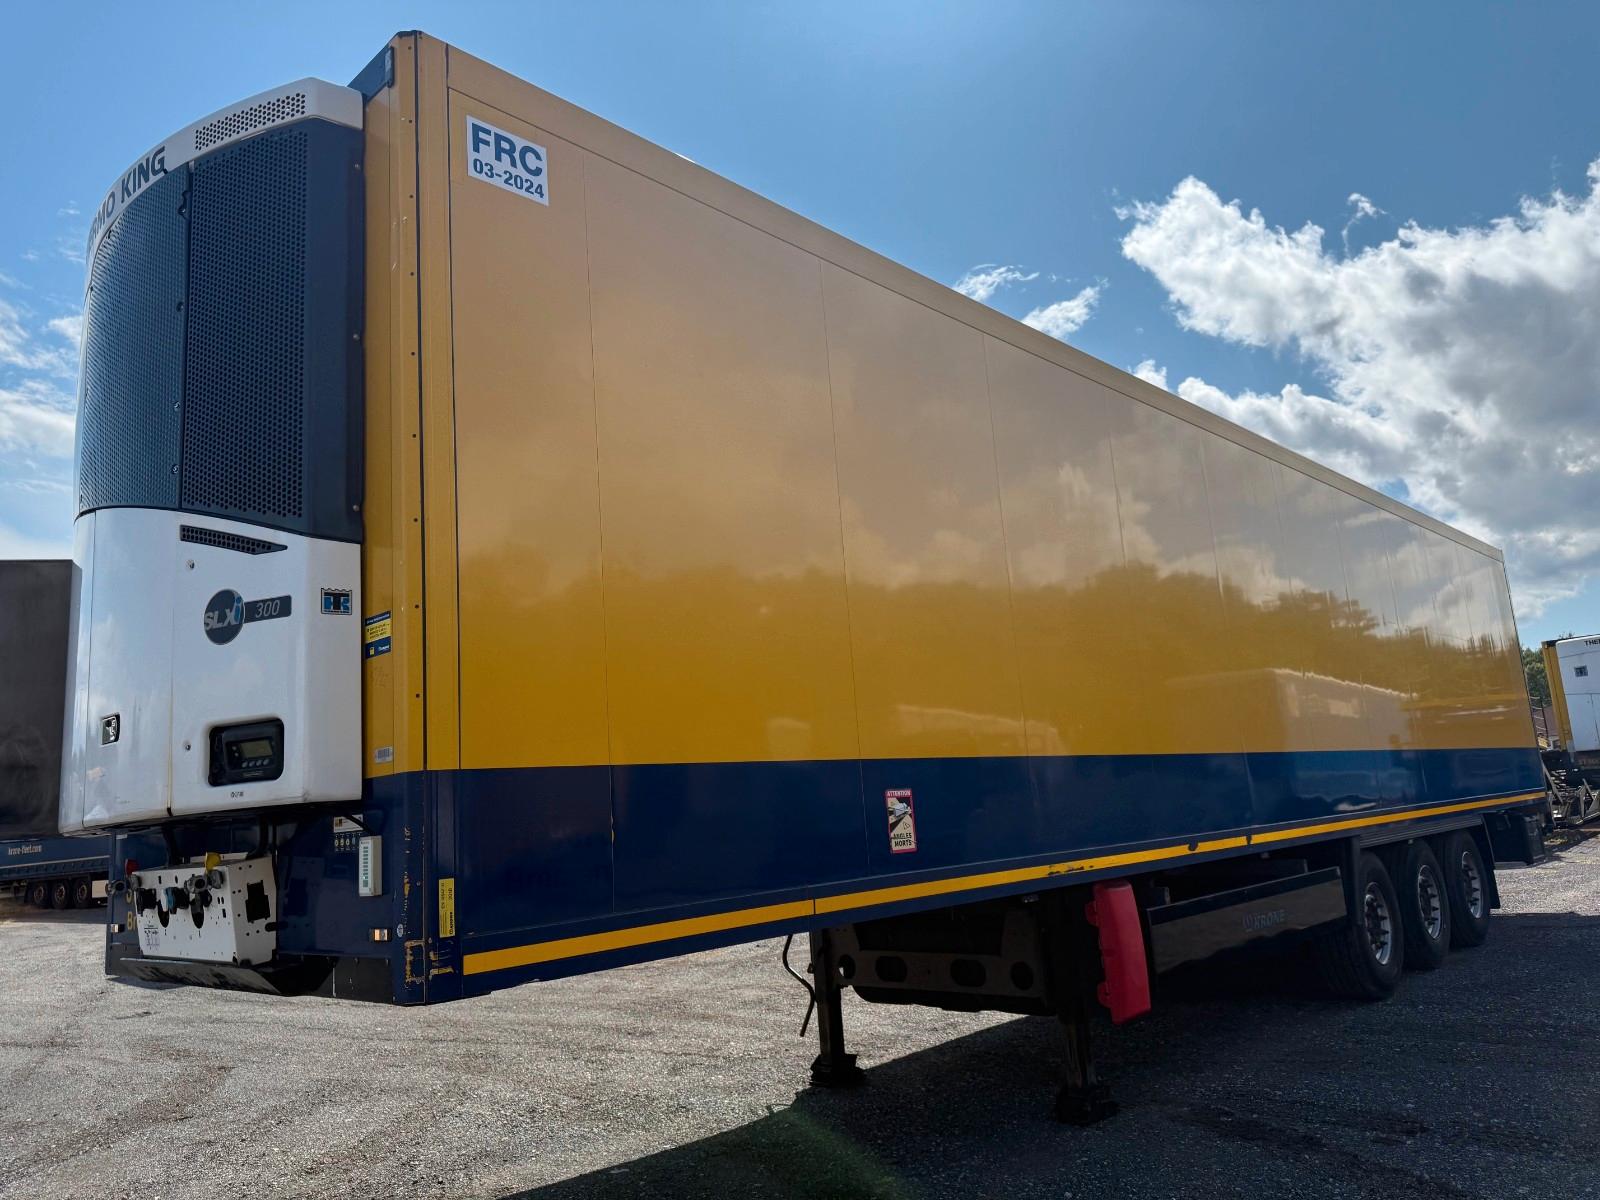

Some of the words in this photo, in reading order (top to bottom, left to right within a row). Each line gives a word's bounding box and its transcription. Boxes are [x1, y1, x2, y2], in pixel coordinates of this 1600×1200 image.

[472, 122, 543, 177] FRC
[121, 145, 166, 204] KING
[473, 158, 545, 199] 03-2024
[255, 600, 280, 618] 300
[894, 839, 912, 847] MORTS
